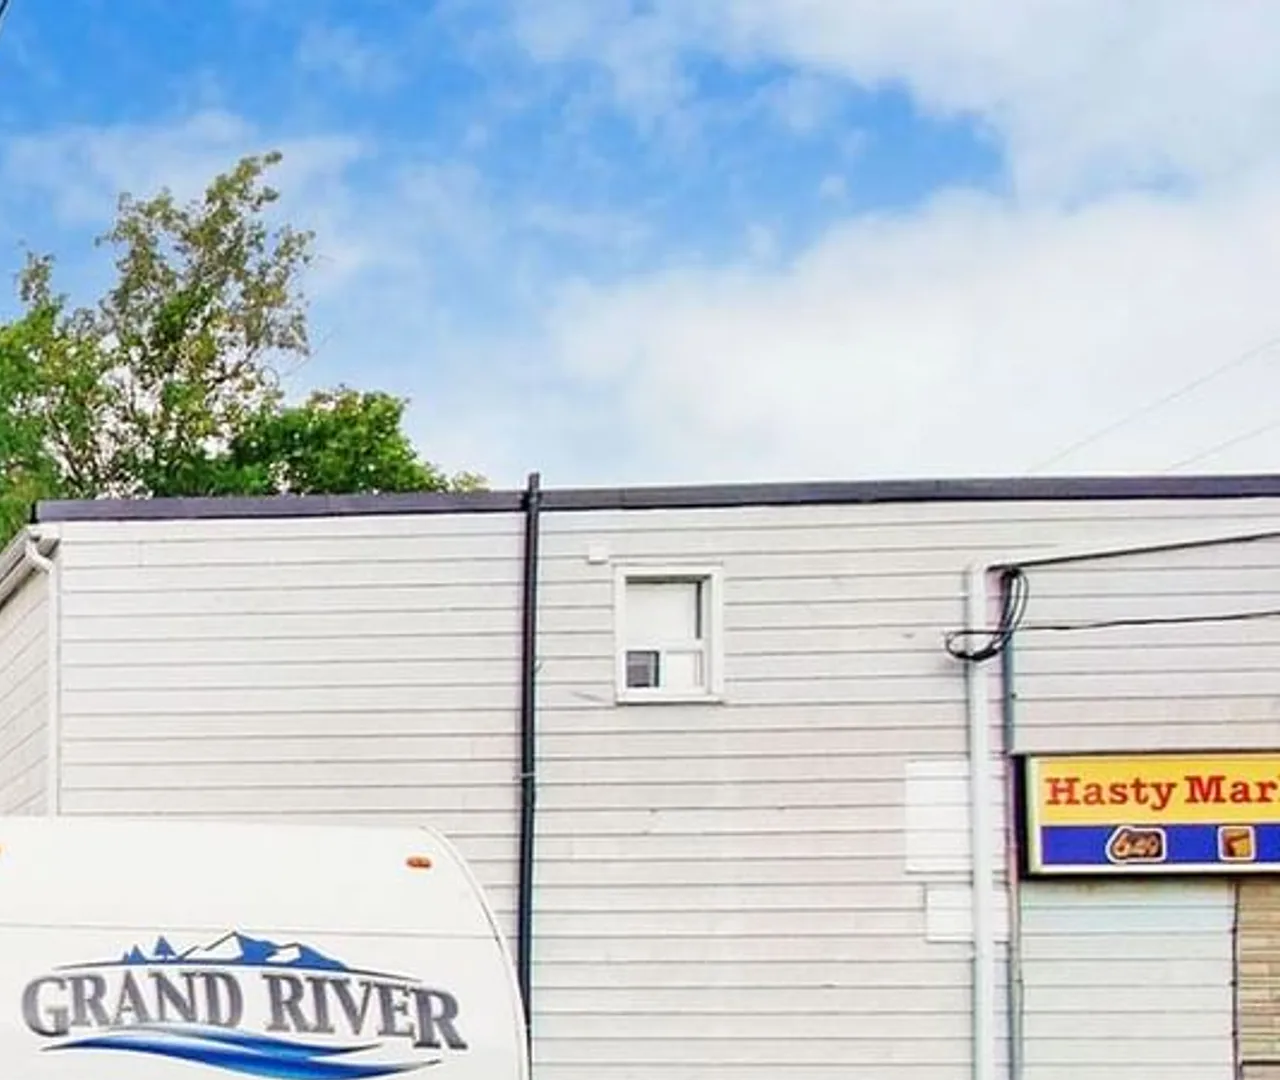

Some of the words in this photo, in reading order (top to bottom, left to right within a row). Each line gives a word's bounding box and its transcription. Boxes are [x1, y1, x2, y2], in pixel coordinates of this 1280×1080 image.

[1045, 775, 1178, 811] Hasty
[1183, 774, 1280, 804] Mar
[21, 969, 244, 1037] GRAND
[261, 974, 468, 1050] RIVER
